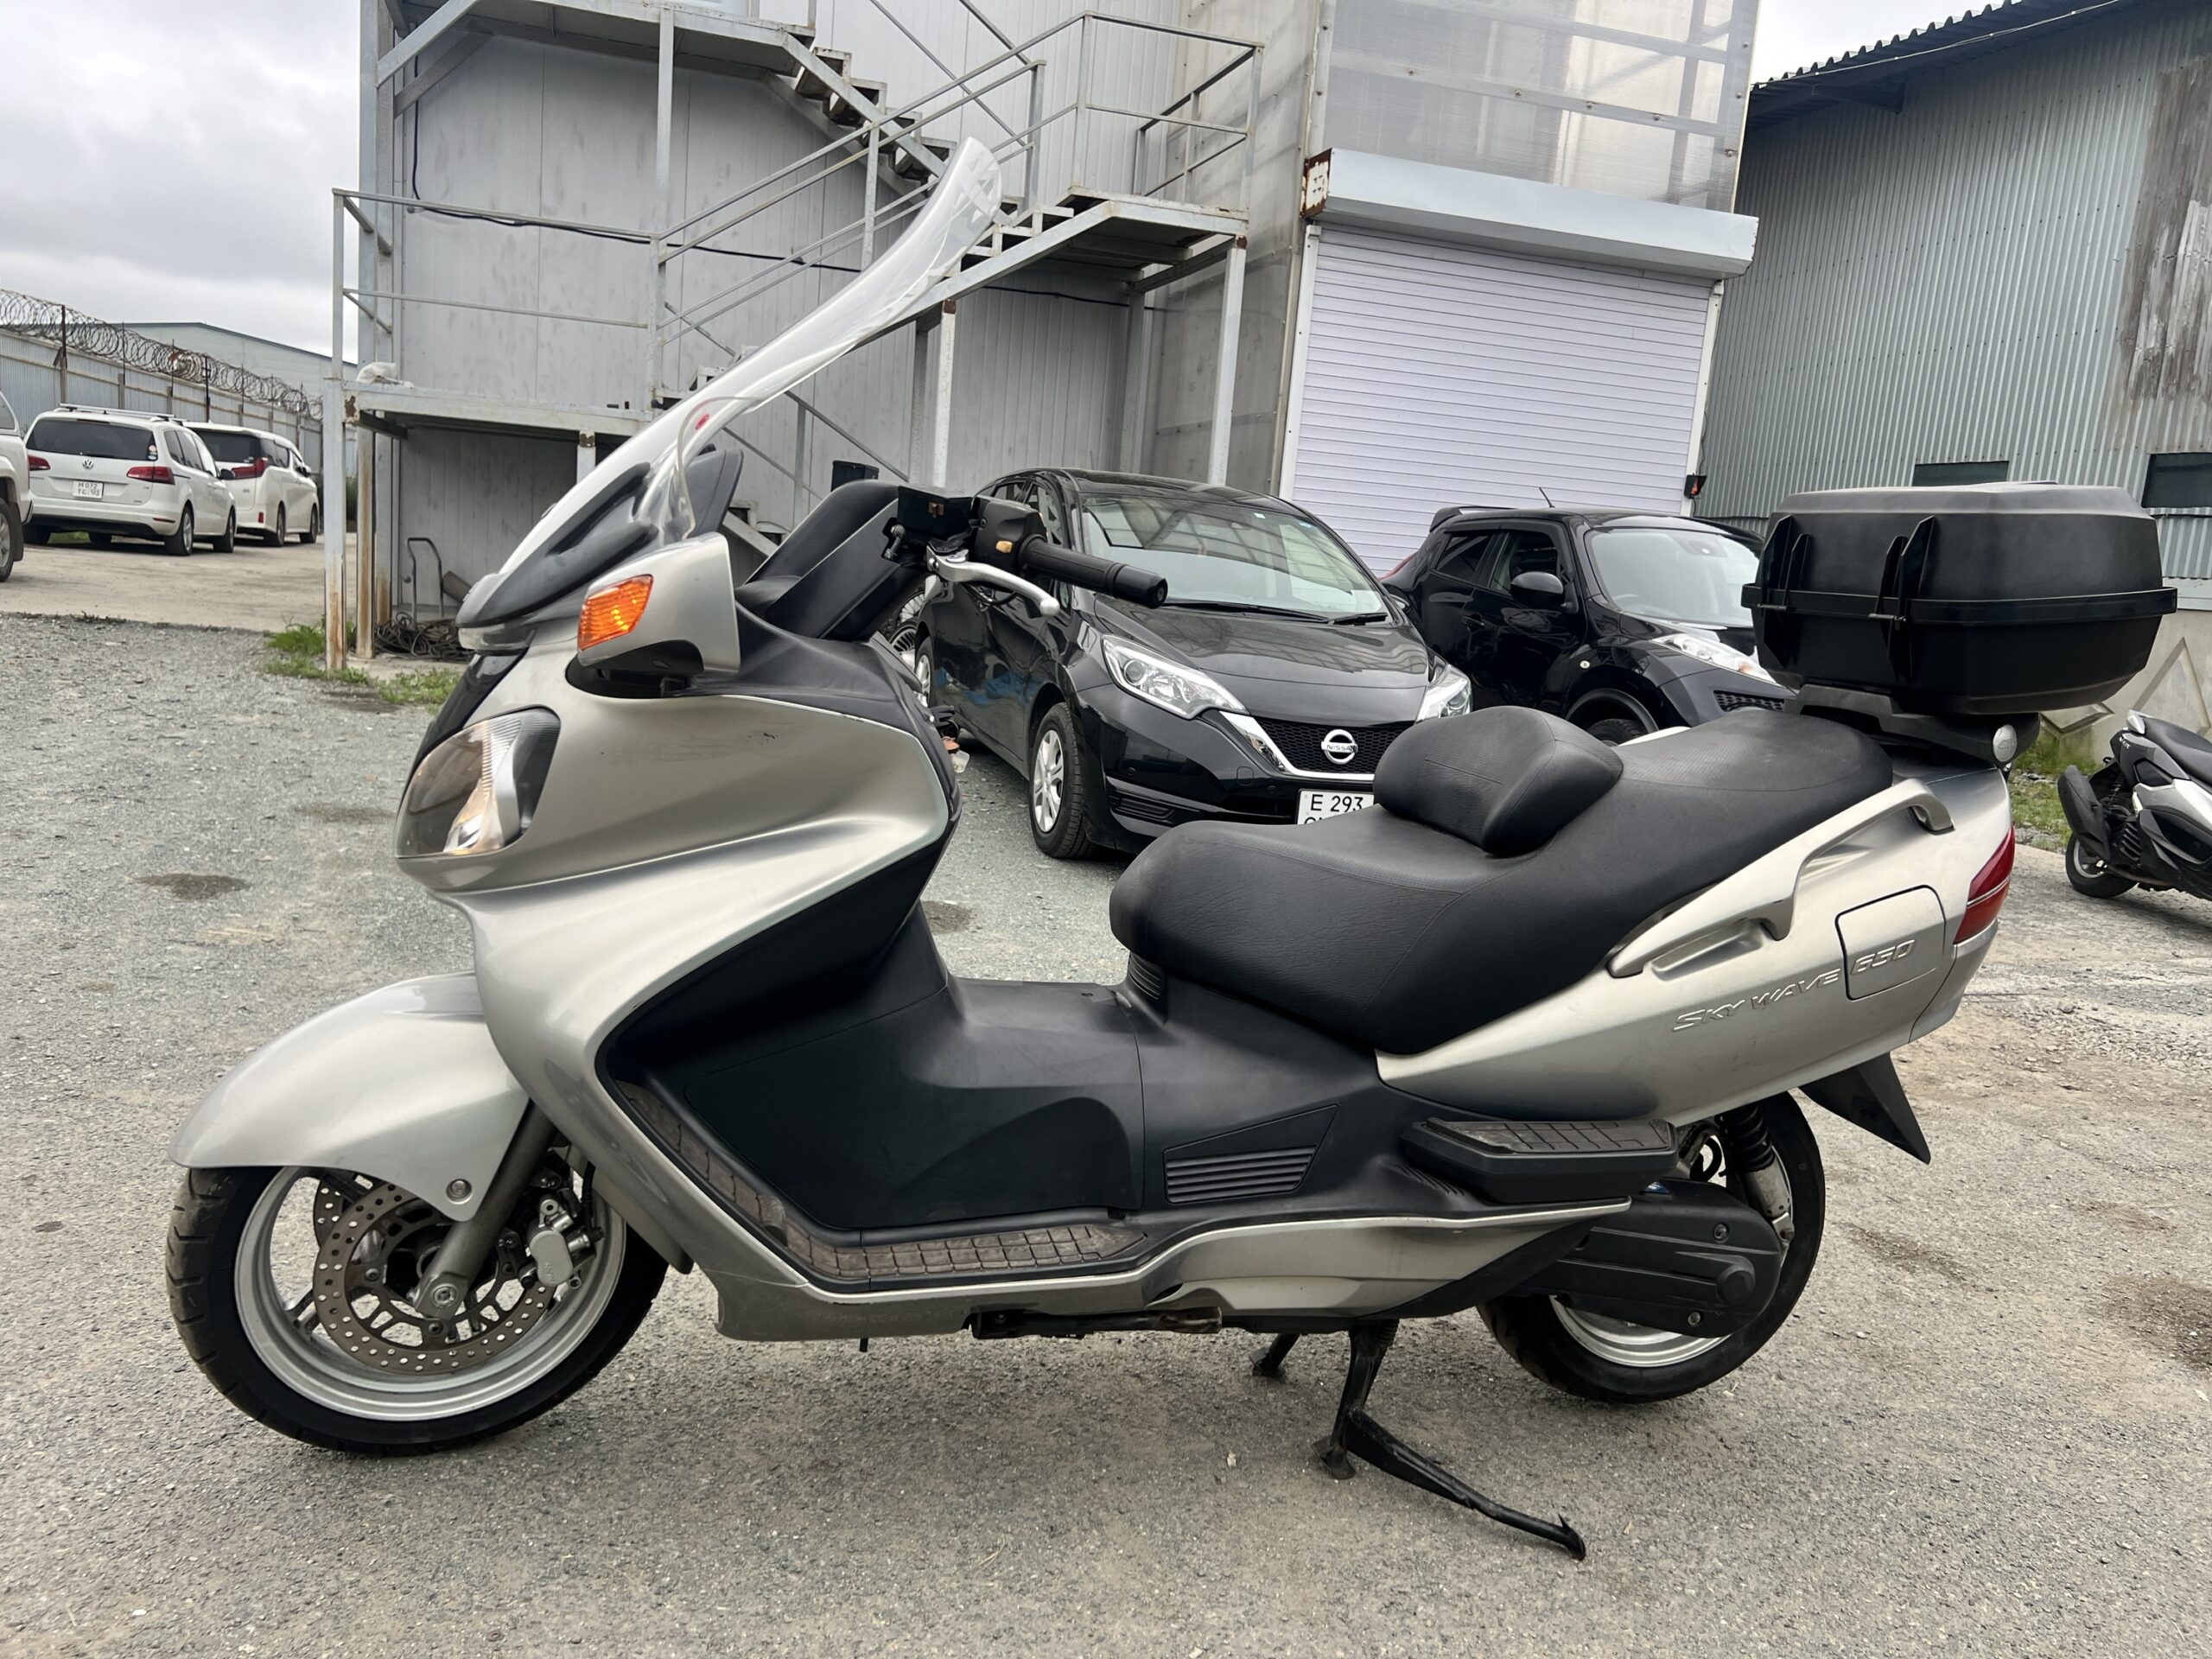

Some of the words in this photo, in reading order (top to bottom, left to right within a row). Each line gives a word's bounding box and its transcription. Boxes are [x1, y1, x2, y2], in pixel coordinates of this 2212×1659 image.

[1311, 794, 1323, 811] E
[1330, 795, 1363, 813] 293
[1672, 999, 1746, 1033] SKY
[1751, 968, 1841, 1010] WAVE
[1850, 938, 1916, 976] 650
